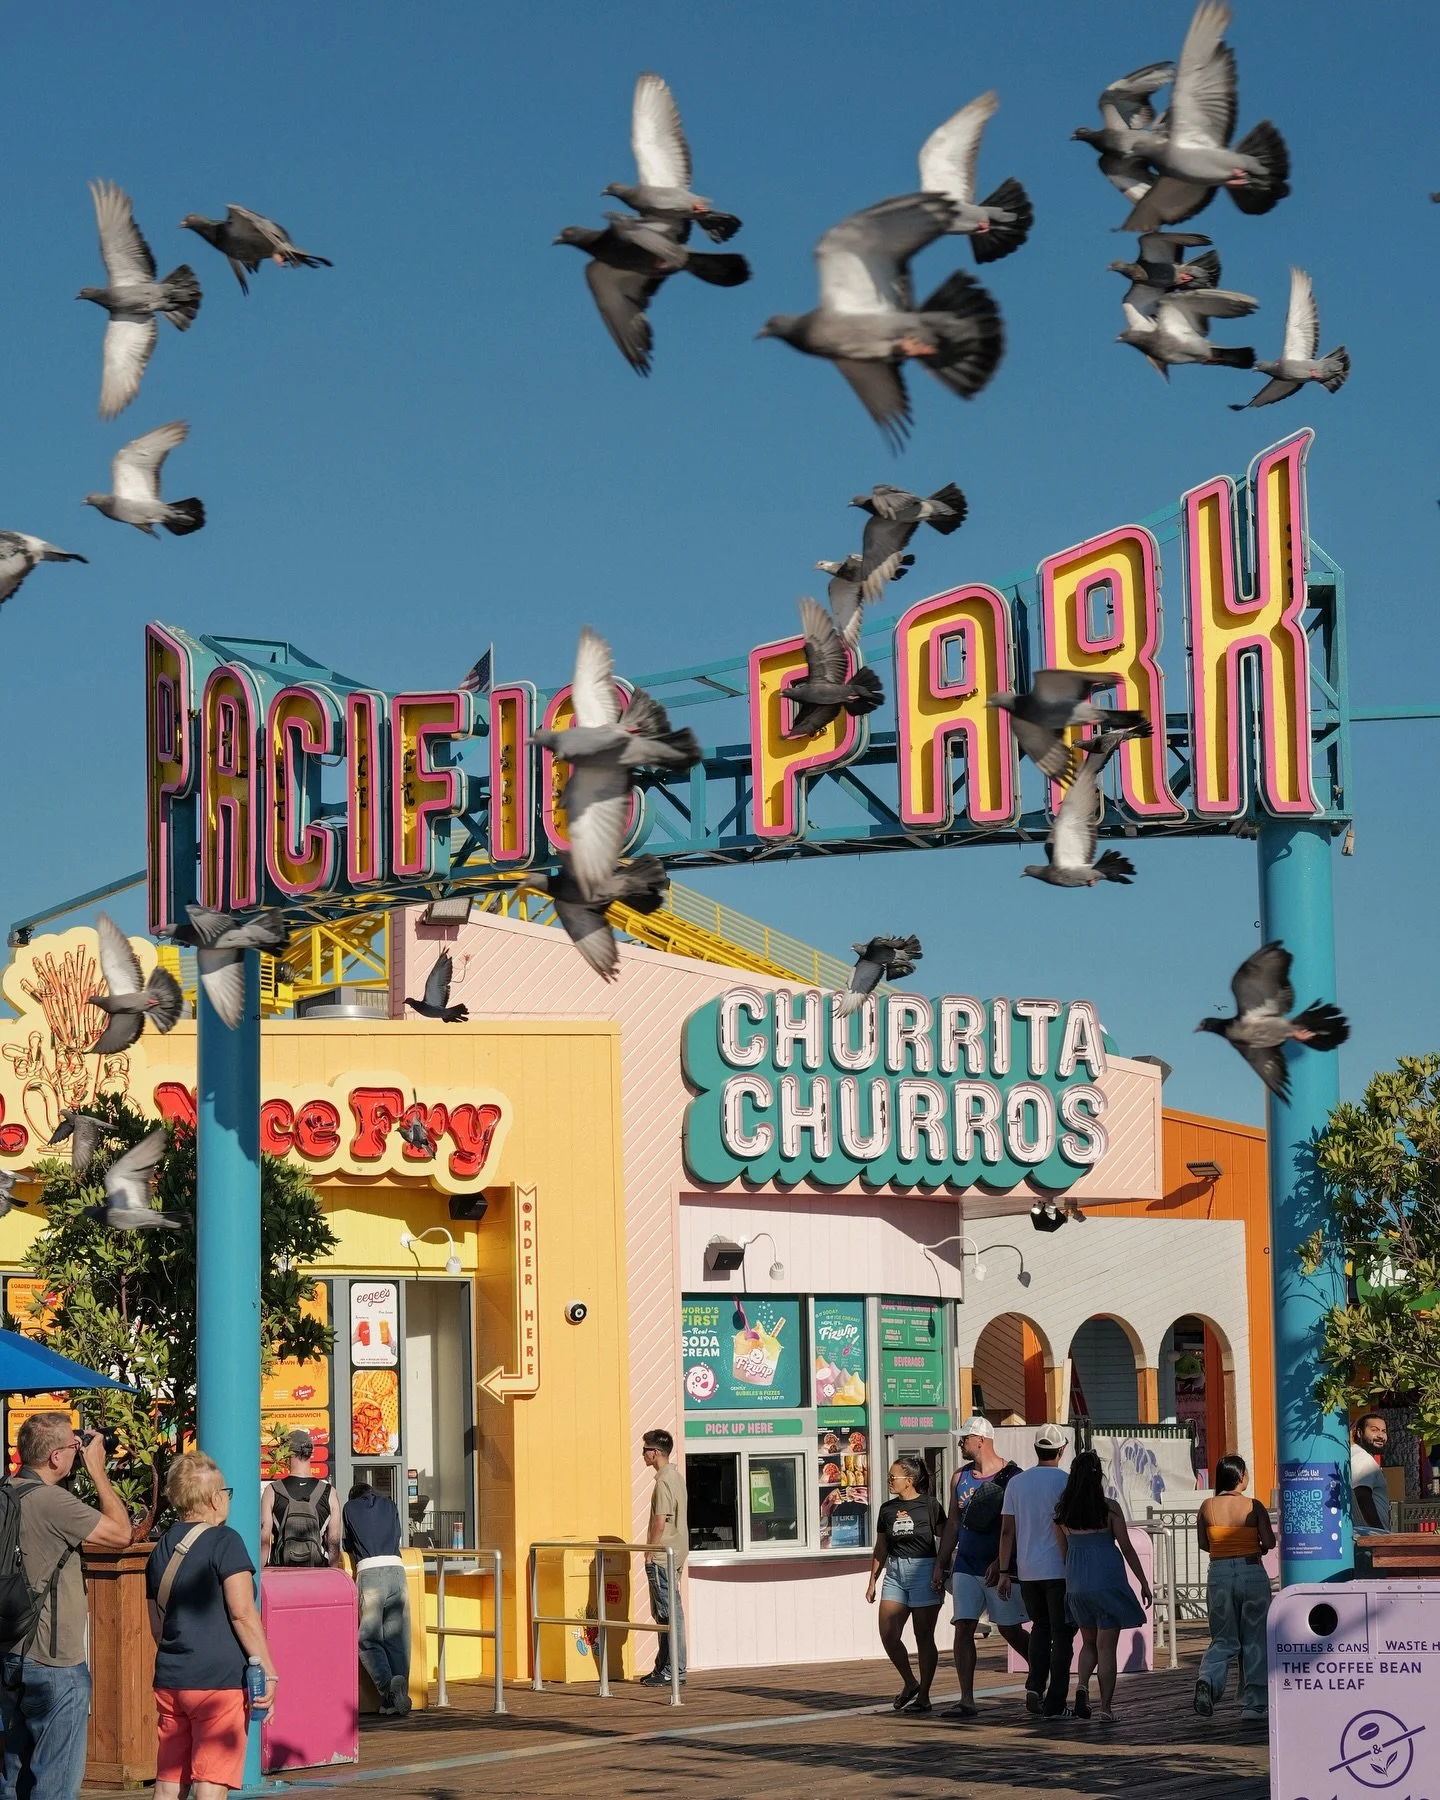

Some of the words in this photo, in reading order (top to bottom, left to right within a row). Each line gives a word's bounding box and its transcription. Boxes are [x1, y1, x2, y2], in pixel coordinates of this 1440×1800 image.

[748, 426, 1325, 841] PARK
[718, 987, 1108, 1079] CHURRITA
[722, 1074, 1109, 1165] CHURROS
[349, 1086, 500, 1177] Fry
[522, 1202, 534, 1286] ORDER
[356, 1288, 391, 1308] eegee's
[682, 1306, 719, 1314] WORLD'S
[682, 1314, 719, 1326] FIRST
[524, 1309, 535, 1376] HERE
[682, 1336, 720, 1348] SODA
[682, 1348, 720, 1357] CREAM
[893, 1356, 925, 1367] BEVERAGES
[705, 1423, 729, 1435] PICK
[731, 1423, 745, 1434] UP
[748, 1422, 774, 1434] HERE
[900, 1416, 918, 1428] ORDER
[919, 1416, 934, 1428] HERE
[758, 1491, 771, 1507] A
[1276, 1643, 1323, 1653] BOTTLES
[1326, 1643, 1334, 1653] &
[1337, 1643, 1369, 1653] CANS
[1385, 1640, 1428, 1651] WASTE
[1282, 1661, 1311, 1674] THE
[1316, 1661, 1374, 1674] COFFEE
[1380, 1661, 1422, 1674] BEAN
[1283, 1678, 1292, 1690] &
[1294, 1678, 1323, 1690] TEA
[1329, 1678, 1365, 1690] LEAF
